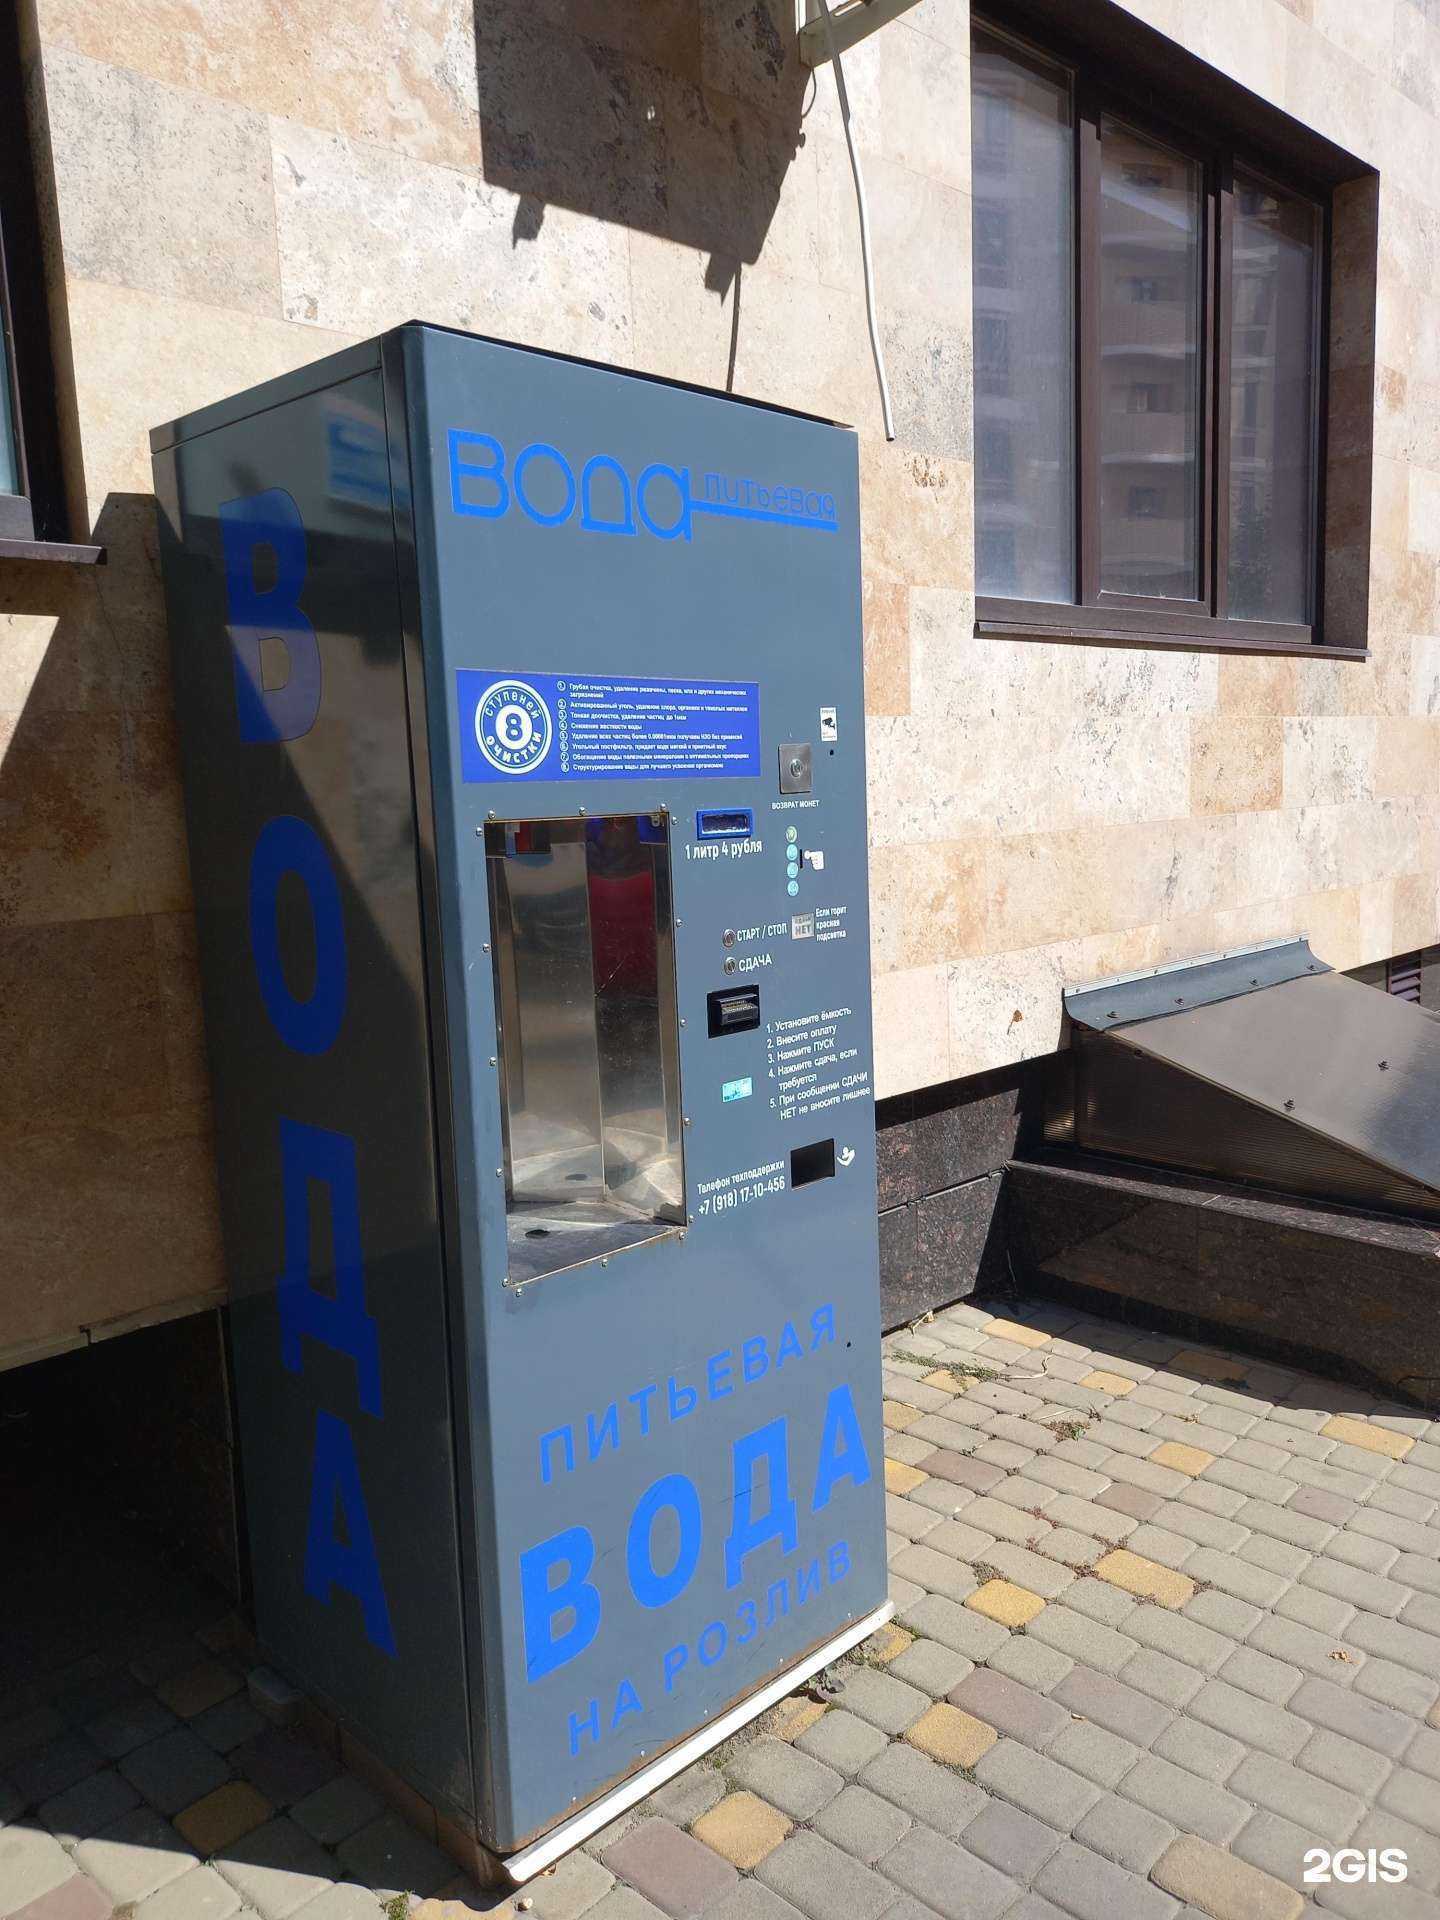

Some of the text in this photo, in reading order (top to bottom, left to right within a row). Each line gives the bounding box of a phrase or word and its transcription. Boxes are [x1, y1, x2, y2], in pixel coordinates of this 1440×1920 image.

[506, 713, 523, 741] 8
[772, 800, 820, 810] ВОЗВРАТ МОНЕТ
[685, 838, 763, 860] 1 литр 4 рубля
[816, 906, 847, 918] Если горит
[816, 919, 840, 930] красная
[737, 922, 788, 942] СТАРТ / СТОП
[795, 925, 812, 936] НЕТ
[738, 954, 773, 972] СДАЧА
[766, 1008, 852, 1034] 1. Установите ёмкость
[767, 1025, 837, 1049] 2. Внесите оплату
[768, 1038, 835, 1064] 3. Нажмите ПУСК
[768, 1048, 858, 1078] 4. Нажмите сдача, если
[219, 487, 397, 1658] ВОДА
[779, 1074, 818, 1092] требуется
[770, 1072, 868, 1108] 5. При сообщении СДАЧИ
[780, 1086, 871, 1120] НЕТ не вносите лишнее
[697, 1160, 785, 1195] Телефон техподдержки
[698, 1176, 786, 1215] +7 (918) 17-10-456
[538, 1302, 837, 1486] ПИТЬЕВАЯ
[519, 1383, 871, 1685] ВОДА
[567, 1540, 853, 1758] НА РОЗЛИВ
